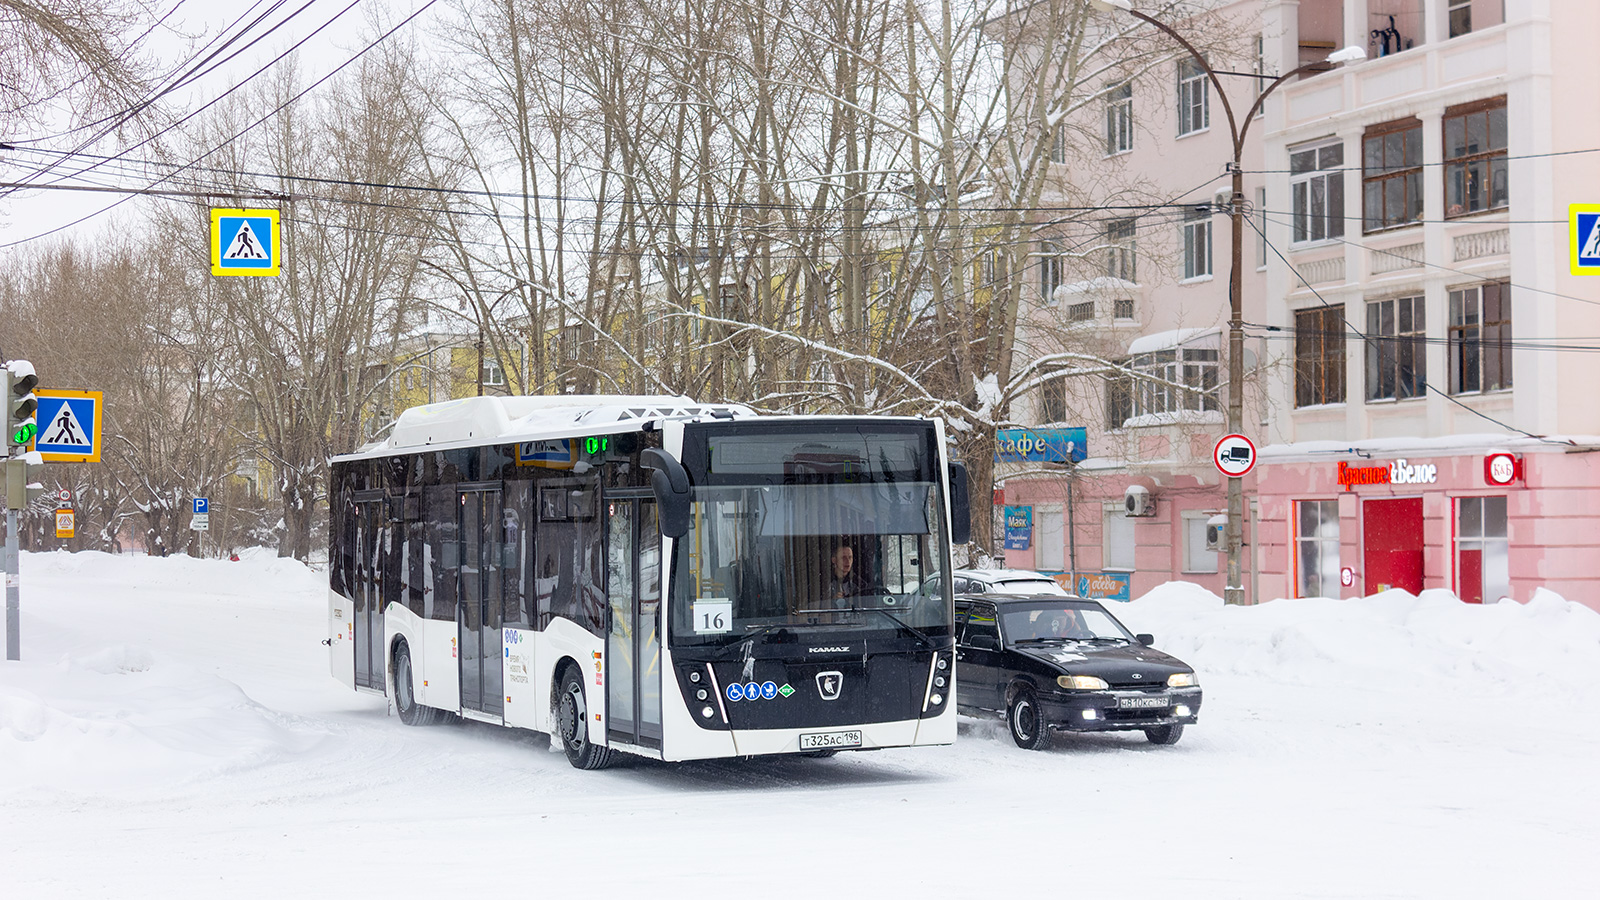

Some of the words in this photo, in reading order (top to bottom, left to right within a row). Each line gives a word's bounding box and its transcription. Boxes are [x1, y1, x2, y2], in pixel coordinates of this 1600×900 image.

[996, 434, 1046, 456] кафе
[196, 500, 205, 511] P
[1008, 516, 1027, 528] Маяк
[1092, 575, 1116, 590] обеда
[703, 612, 724, 629] 16
